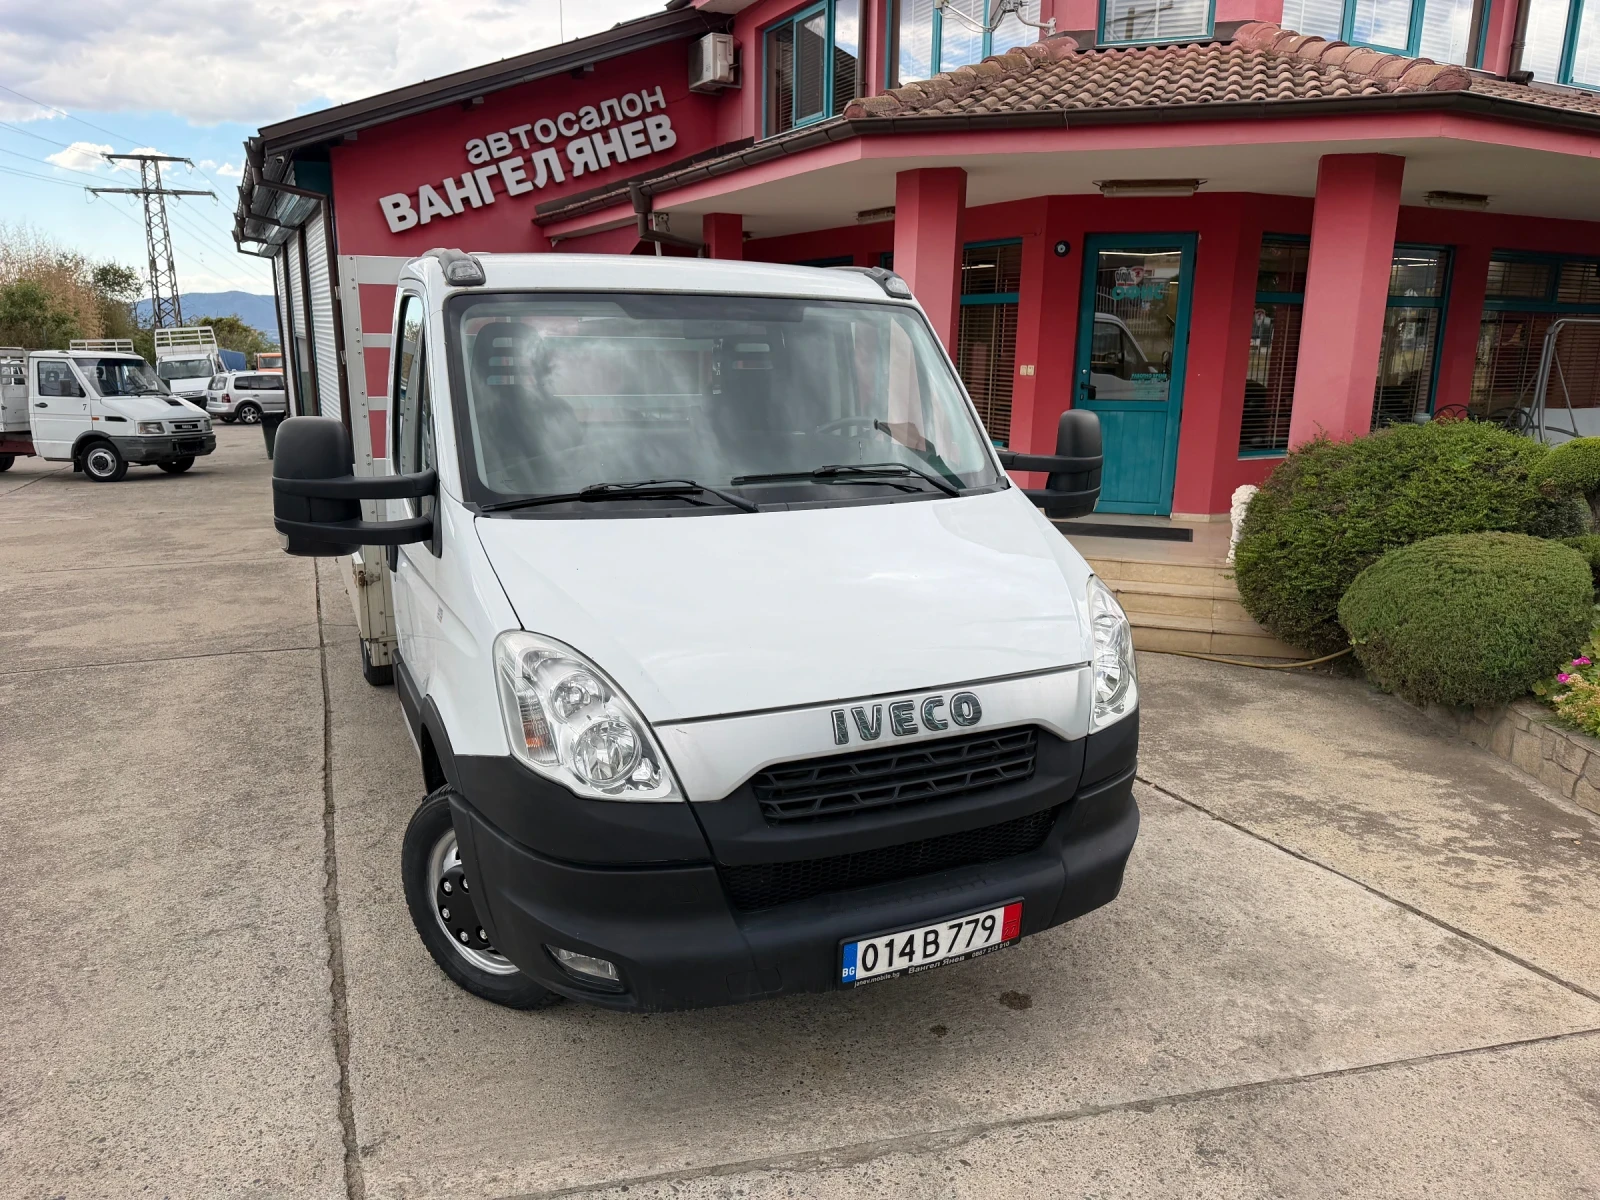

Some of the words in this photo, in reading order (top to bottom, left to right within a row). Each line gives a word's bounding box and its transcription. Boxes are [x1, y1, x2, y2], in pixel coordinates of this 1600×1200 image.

[465, 85, 667, 165] автосалон
[379, 147, 566, 233] ВАНГЕЛ
[565, 114, 677, 177] ЯНЕВ
[831, 691, 983, 745] IVECO
[842, 966, 856, 977] BG
[908, 961, 941, 974] Вангел
[942, 955, 965, 966] Янев
